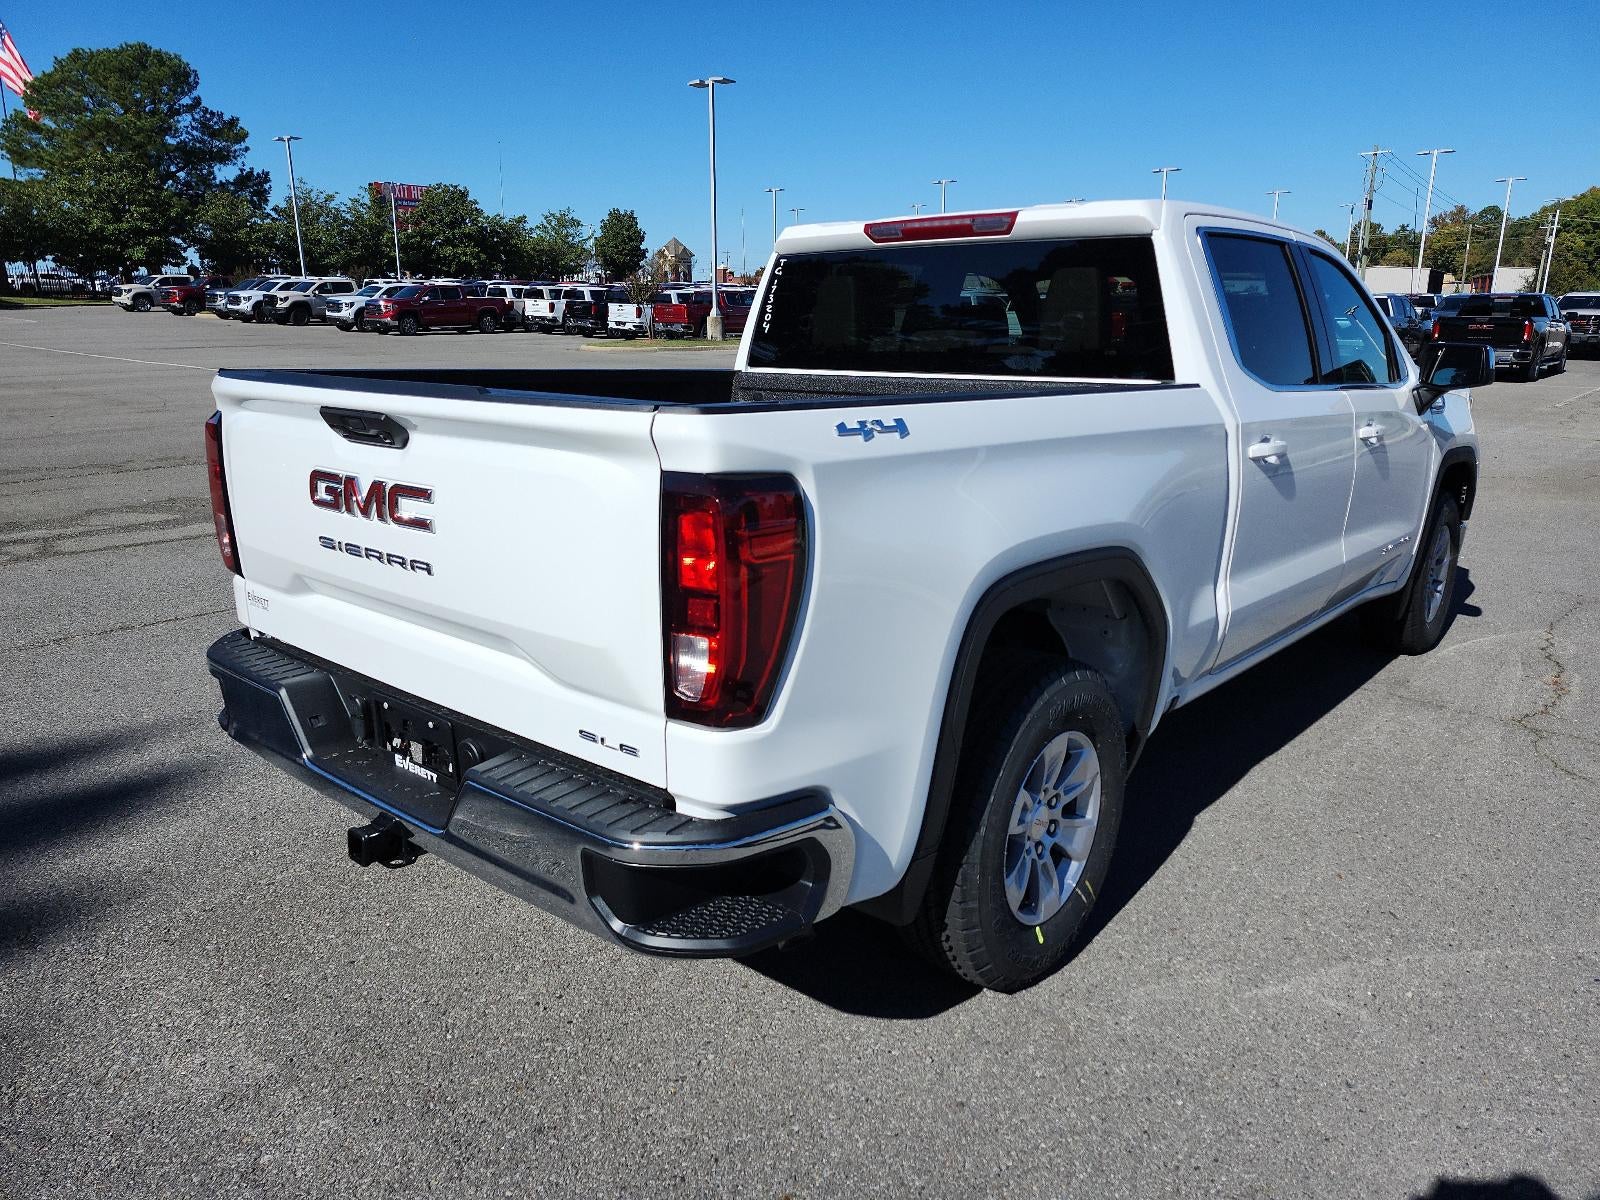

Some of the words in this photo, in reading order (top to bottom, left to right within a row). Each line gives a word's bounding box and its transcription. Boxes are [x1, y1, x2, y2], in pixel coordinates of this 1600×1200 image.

[309, 468, 436, 534] GMC
[318, 535, 435, 576] SIERRA
[578, 729, 640, 758] SLE
[394, 753, 438, 783] EVERETT
